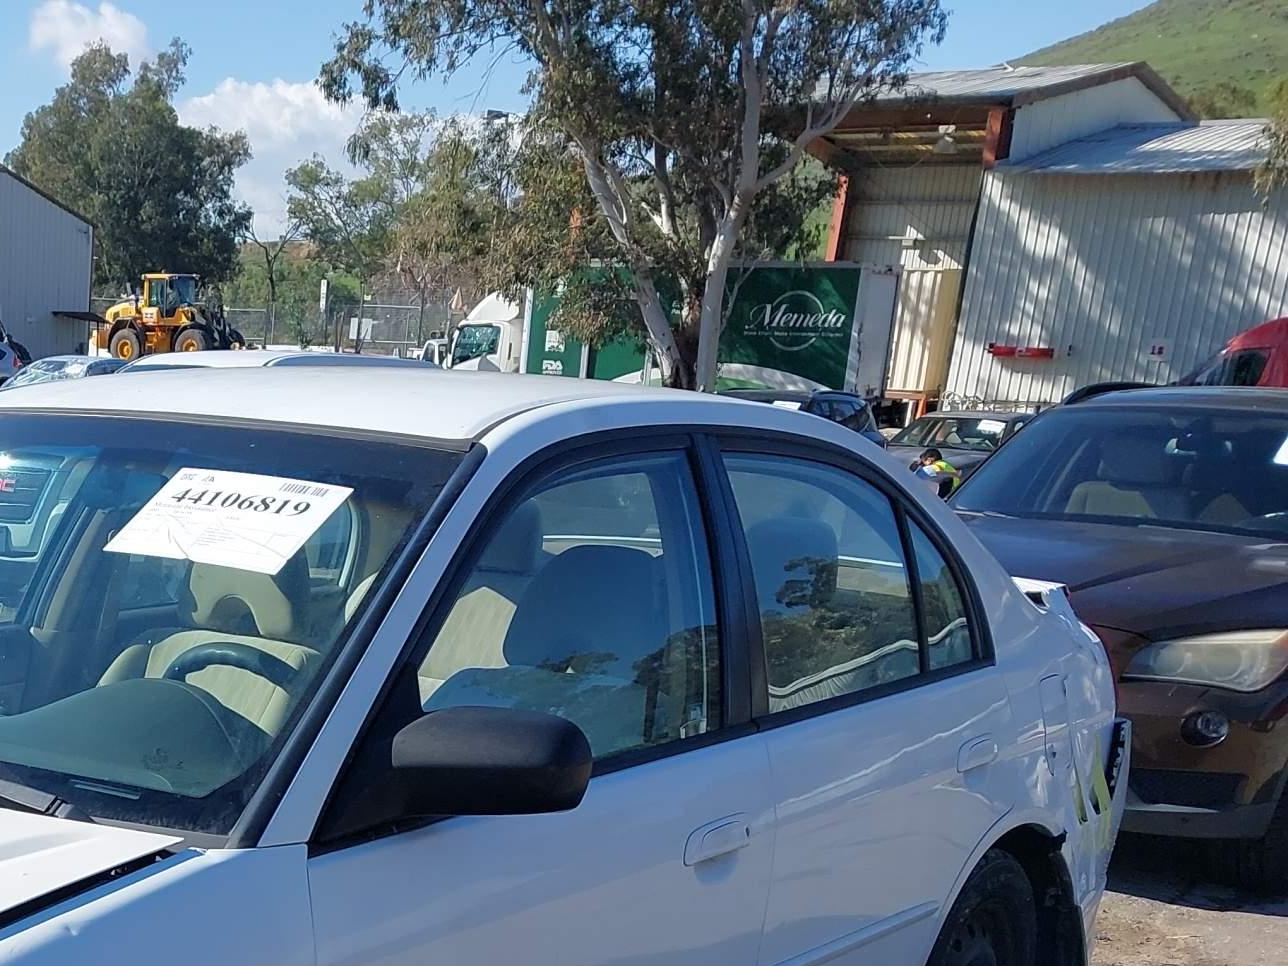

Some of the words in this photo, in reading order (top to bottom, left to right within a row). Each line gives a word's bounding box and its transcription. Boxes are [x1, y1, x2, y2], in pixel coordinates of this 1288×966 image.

[744, 303, 846, 329] Memeda
[541, 360, 563, 371] FDA
[171, 487, 311, 517] 44106819
